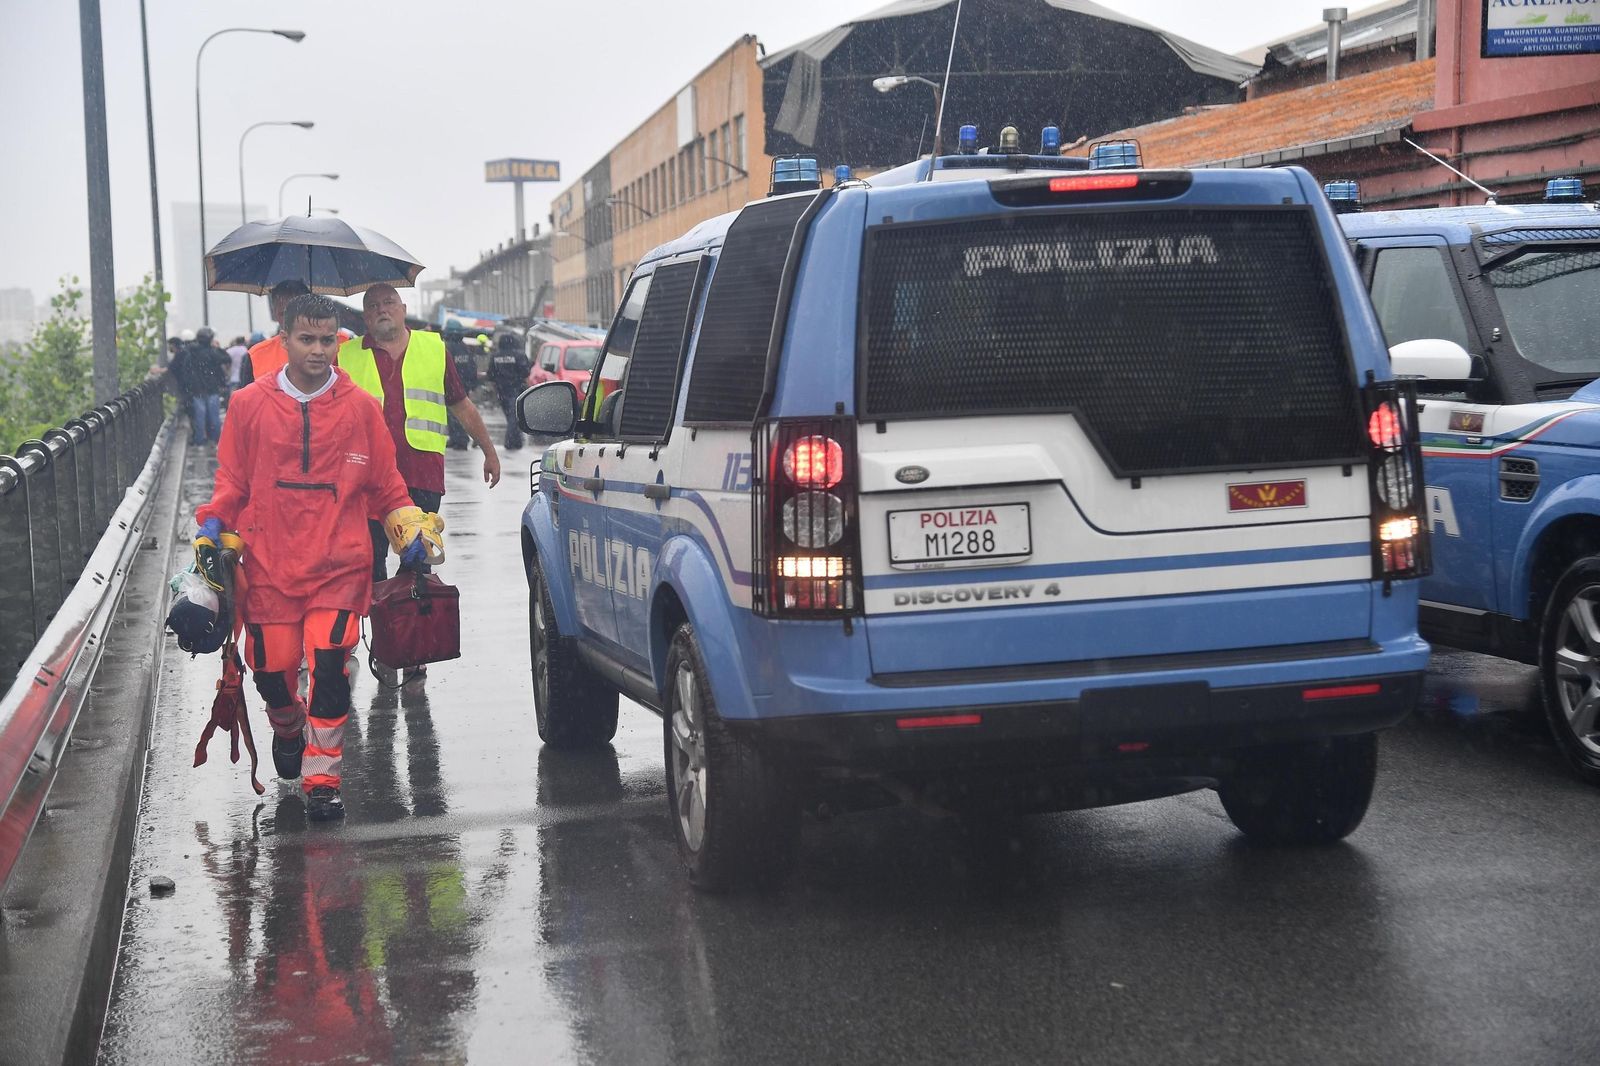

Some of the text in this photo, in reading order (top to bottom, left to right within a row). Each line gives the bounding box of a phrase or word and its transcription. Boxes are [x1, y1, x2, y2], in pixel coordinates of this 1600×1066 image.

[1504, 26, 1600, 37] MANIFATTURA GUARNIZIONI
[1506, 36, 1538, 44] MACCHINE
[1539, 35, 1562, 43] NAVALI
[1523, 43, 1582, 52] ARTICOLI TECNICI
[511, 162, 558, 178] IKEA
[963, 234, 1218, 277] POLIZIA
[920, 509, 998, 529] POLIZIA
[925, 529, 996, 557] M1288
[568, 529, 651, 601] POLIZIA
[893, 581, 1062, 607] DISCOVERY 4
